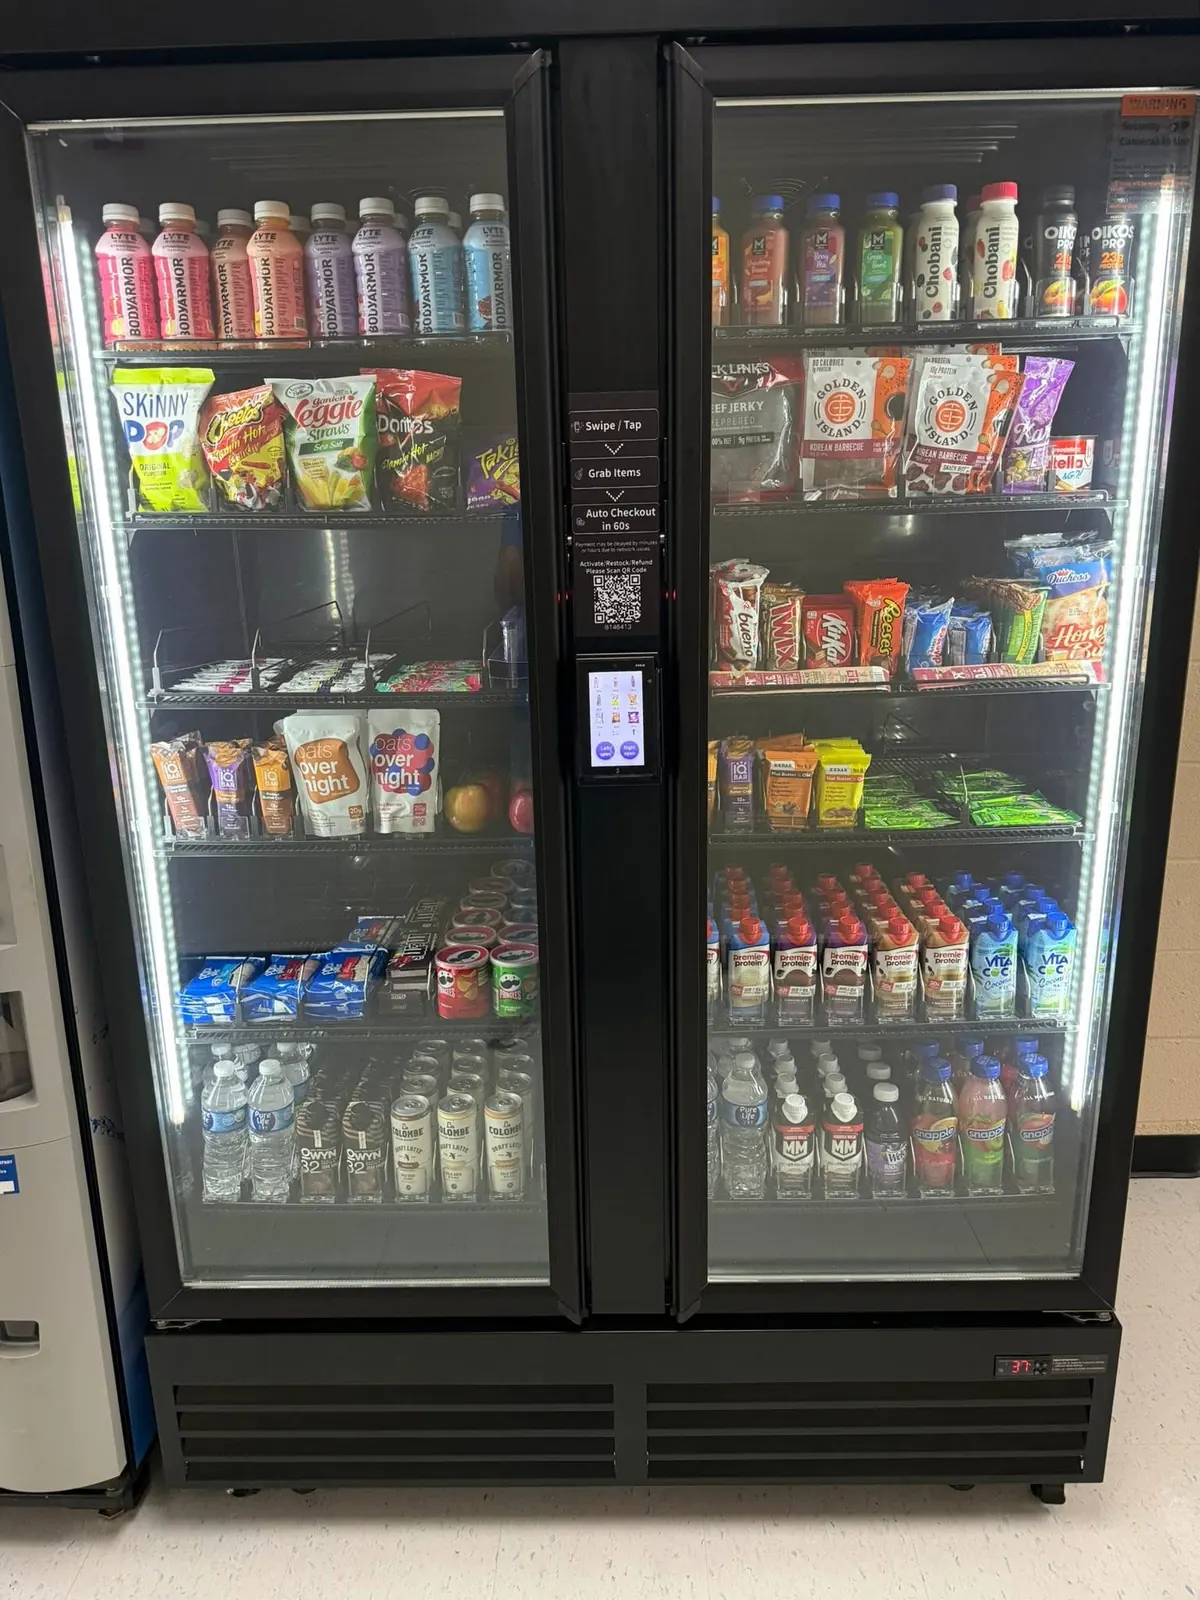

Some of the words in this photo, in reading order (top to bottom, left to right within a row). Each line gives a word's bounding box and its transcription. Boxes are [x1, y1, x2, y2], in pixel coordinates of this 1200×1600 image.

[110, 233, 137, 241] LYTE
[163, 233, 190, 241] LYTE
[254, 232, 276, 240] LYTE
[358, 228, 382, 236] LYTE
[1092, 224, 1134, 241] OIKOS
[216, 239, 235, 247] YTE
[1102, 238, 1126, 250] PRO
[925, 226, 942, 298] Chobani
[983, 226, 1000, 298] Chobani
[120, 256, 142, 337] BODYARMOR
[322, 258, 338, 338] BODYARMOR
[365, 252, 379, 334] BODYARMOR
[820, 358, 844, 367] CALORIES
[817, 378, 867, 400] GOLDEN
[929, 387, 978, 410] GOLDEN
[294, 395, 363, 429] Veggie
[728, 401, 764, 414] JERKY
[378, 414, 434, 434] Doritos
[586, 421, 616, 432] Swipe
[624, 420, 642, 431] Tap
[816, 418, 862, 438] ISLAND
[124, 419, 185, 451] POP
[924, 426, 970, 446] ISLAND
[834, 442, 864, 452] BARBECUE
[938, 450, 969, 462] BARBECUE
[588, 468, 612, 478] Grab
[614, 468, 641, 478] Items
[586, 509, 608, 518] Auto
[610, 508, 656, 518] Checkout
[602, 522, 611, 530] in
[614, 522, 630, 530] 60s
[880, 598, 902, 656] Reese's
[738, 612, 753, 657] bueno
[770, 600, 798, 668] TWIX
[375, 736, 412, 751] oats
[297, 744, 332, 759] oats
[375, 754, 414, 767] over
[300, 760, 338, 776] over
[304, 774, 350, 796] night
[375, 770, 420, 788] night
[985, 955, 1012, 967] VITA
[1042, 953, 1068, 965] VITA
[982, 968, 1011, 977] COC
[1038, 965, 1067, 975] COC
[255, 1110, 272, 1120] Pure
[739, 1106, 757, 1114] Pure
[741, 1112, 755, 1120] Life
[393, 1127, 424, 1138] COLOMBE
[915, 1127, 956, 1140] snapple
[1012, 1360, 1029, 1373] 37
